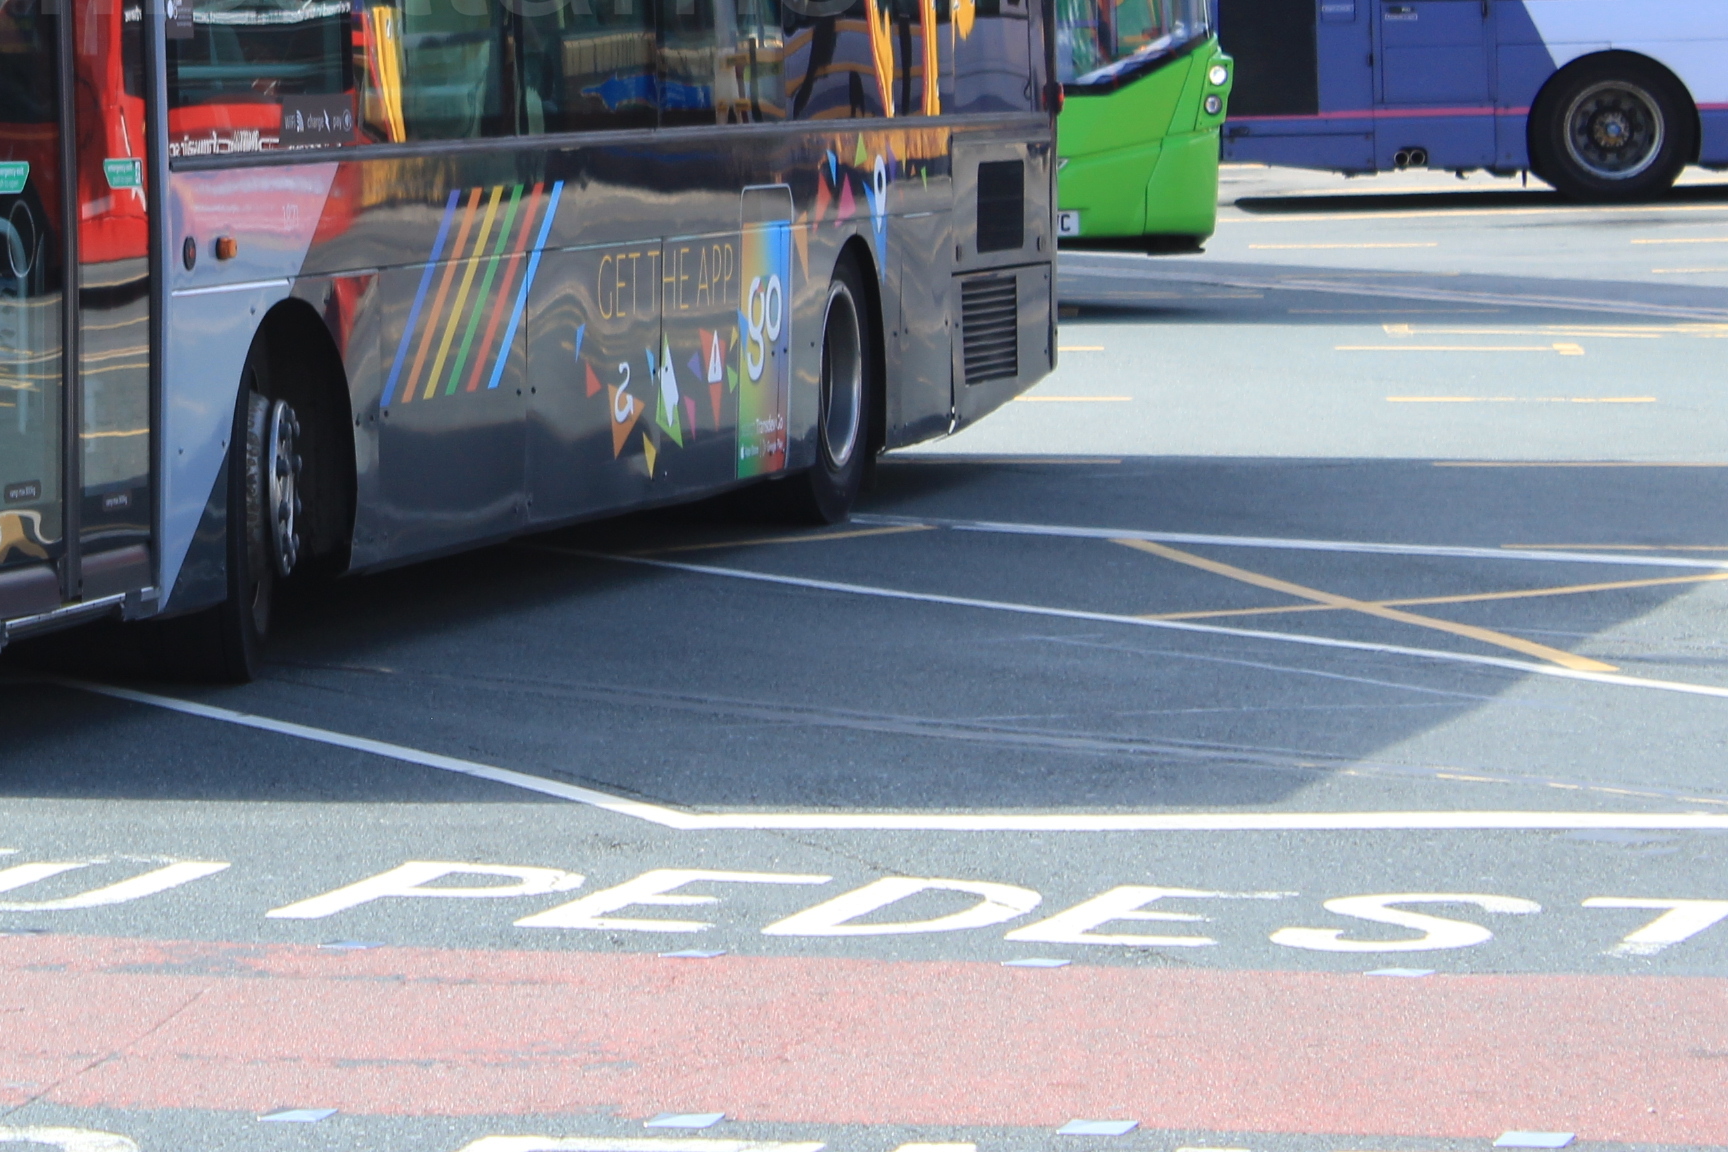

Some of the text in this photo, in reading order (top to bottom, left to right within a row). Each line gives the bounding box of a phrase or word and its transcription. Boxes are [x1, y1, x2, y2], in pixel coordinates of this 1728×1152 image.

[598, 243, 734, 320] GET THE APP
[746, 274, 783, 382] go
